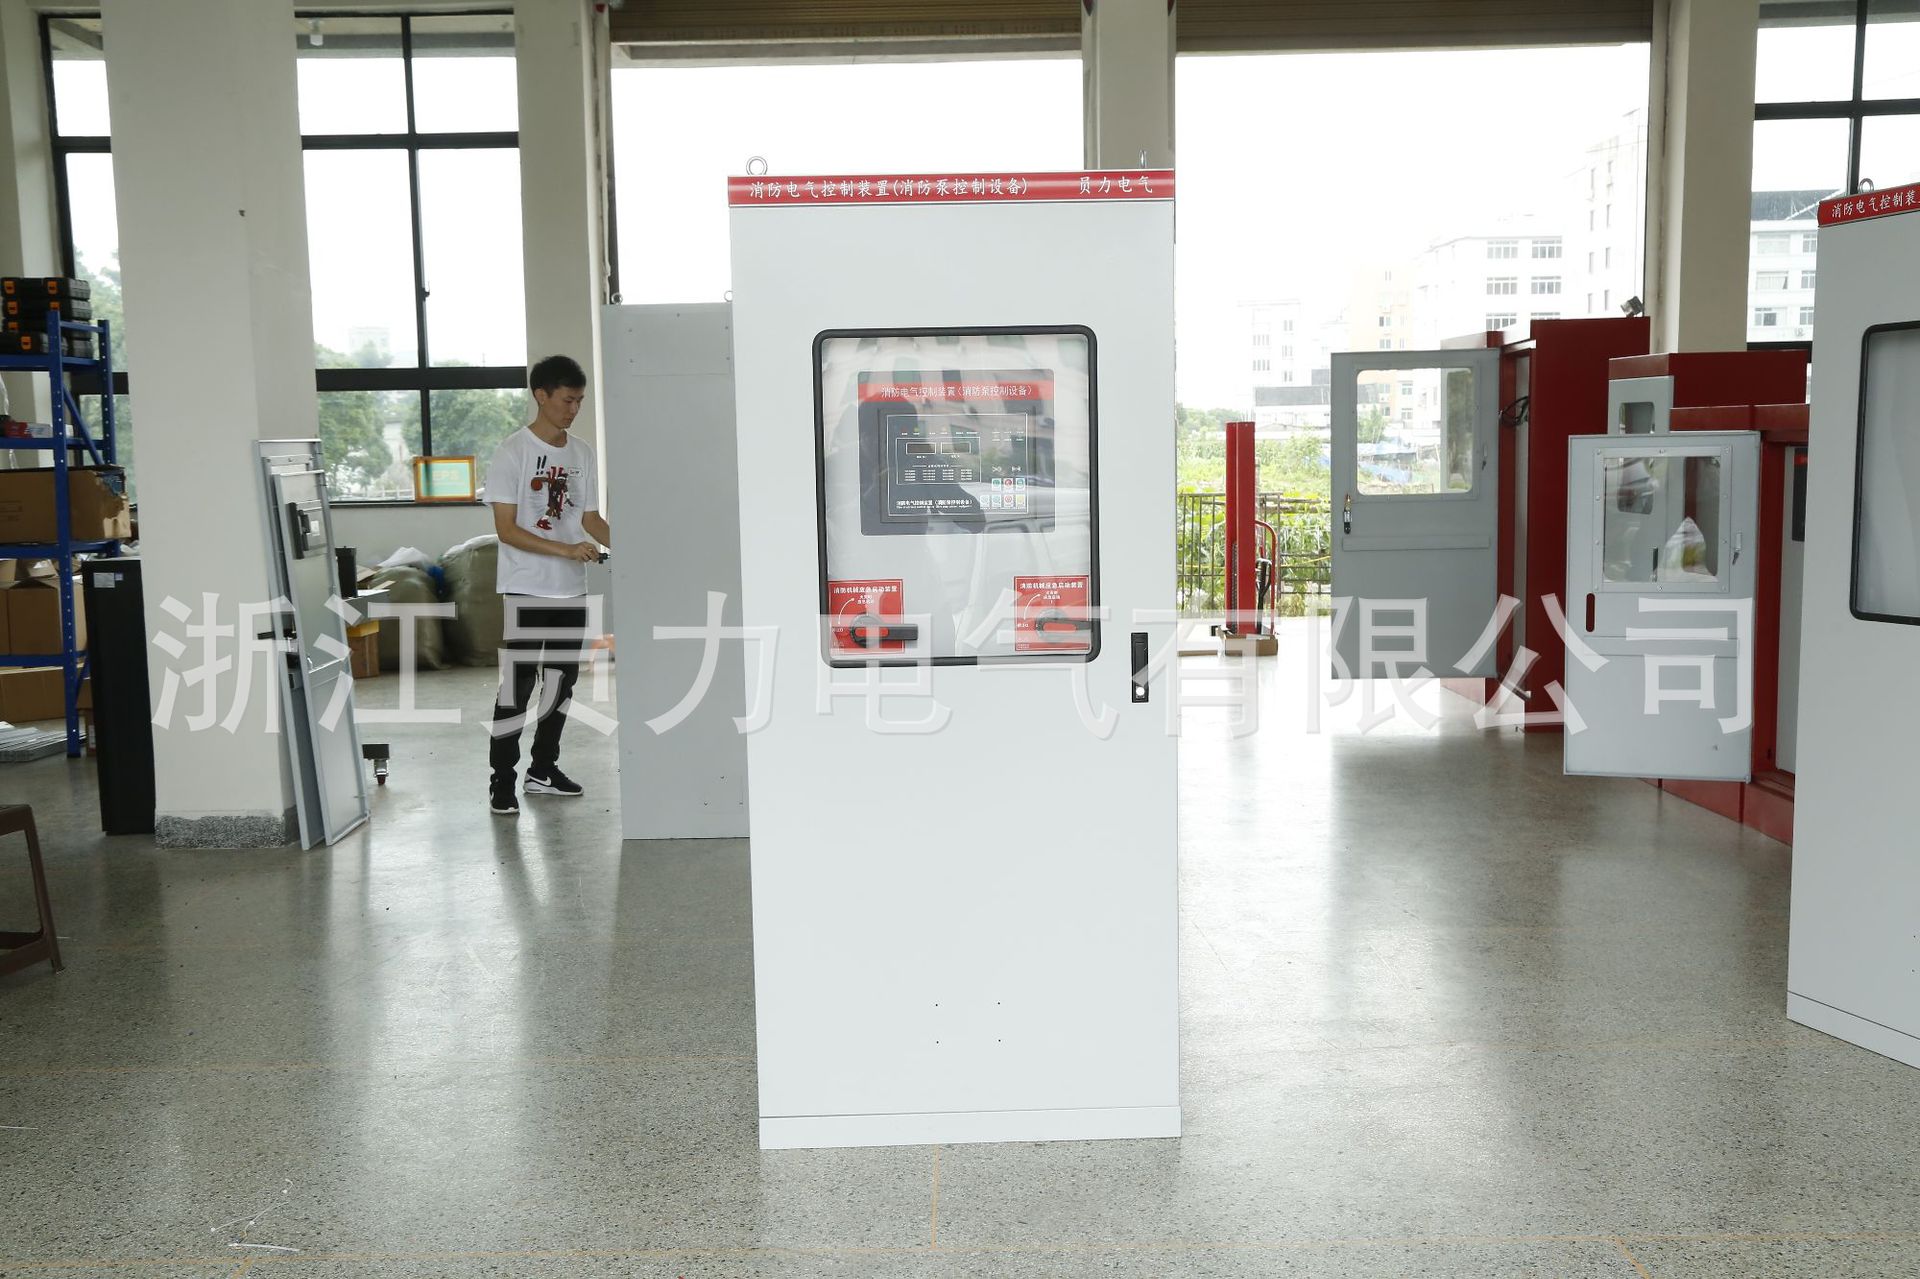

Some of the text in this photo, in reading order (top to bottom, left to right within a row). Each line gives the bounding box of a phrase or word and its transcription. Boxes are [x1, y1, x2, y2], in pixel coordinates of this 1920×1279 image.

[750, 175, 1153, 199] 消防电气控制装置(消防泵控制设备) 员力电气
[1831, 189, 1920, 218] 消防电气控制装
